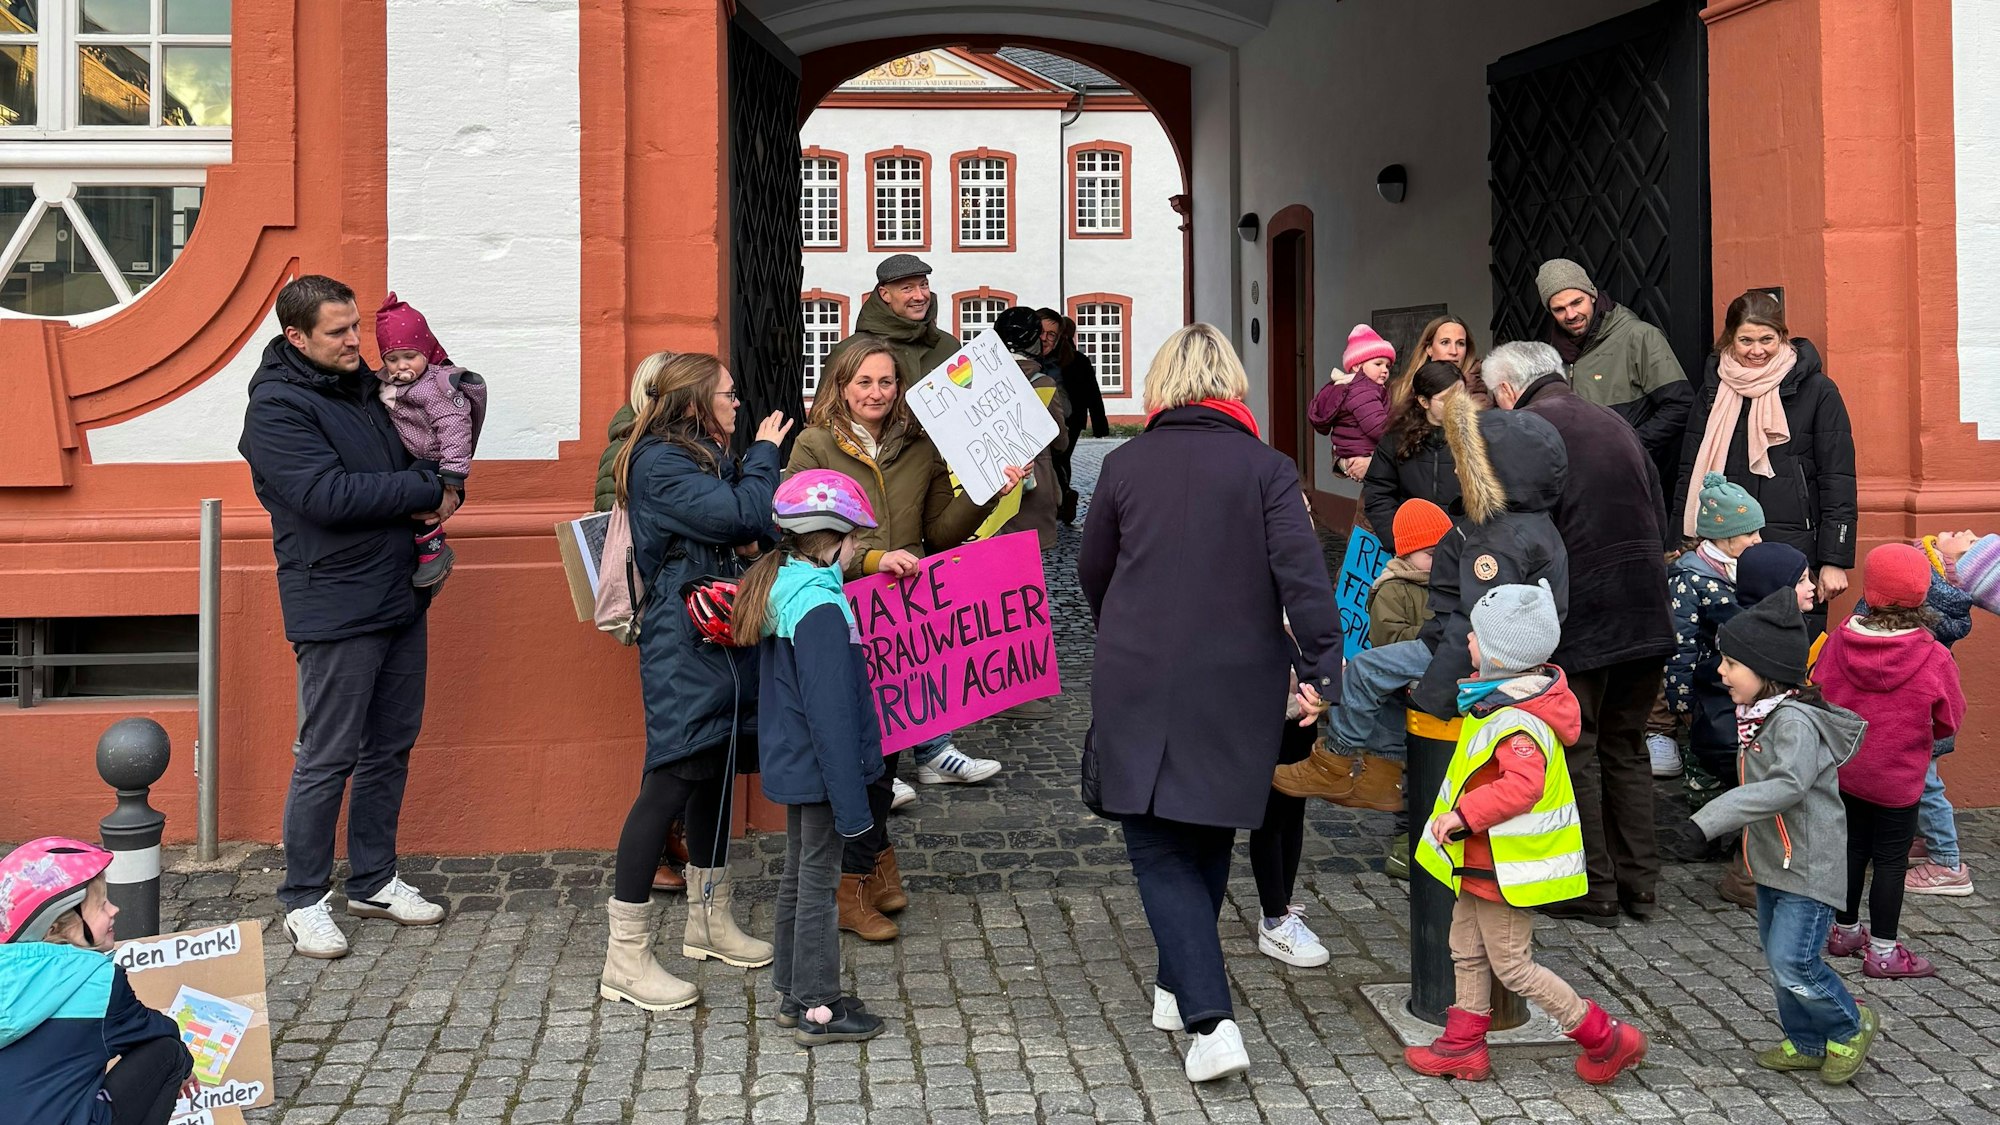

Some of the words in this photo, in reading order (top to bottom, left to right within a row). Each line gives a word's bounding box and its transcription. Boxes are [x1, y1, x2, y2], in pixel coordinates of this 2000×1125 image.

[917, 382, 958, 418] Ein
[971, 342, 1003, 375] für
[963, 376, 1017, 427] UNSEREN
[966, 402, 1043, 493] PARK
[1356, 535, 1391, 580] RE
[1343, 570, 1371, 614] FE
[961, 633, 1050, 707] AGAIN
[120, 947, 165, 968] den
[175, 929, 236, 959] Park!
[190, 1084, 259, 1112] Kinder
